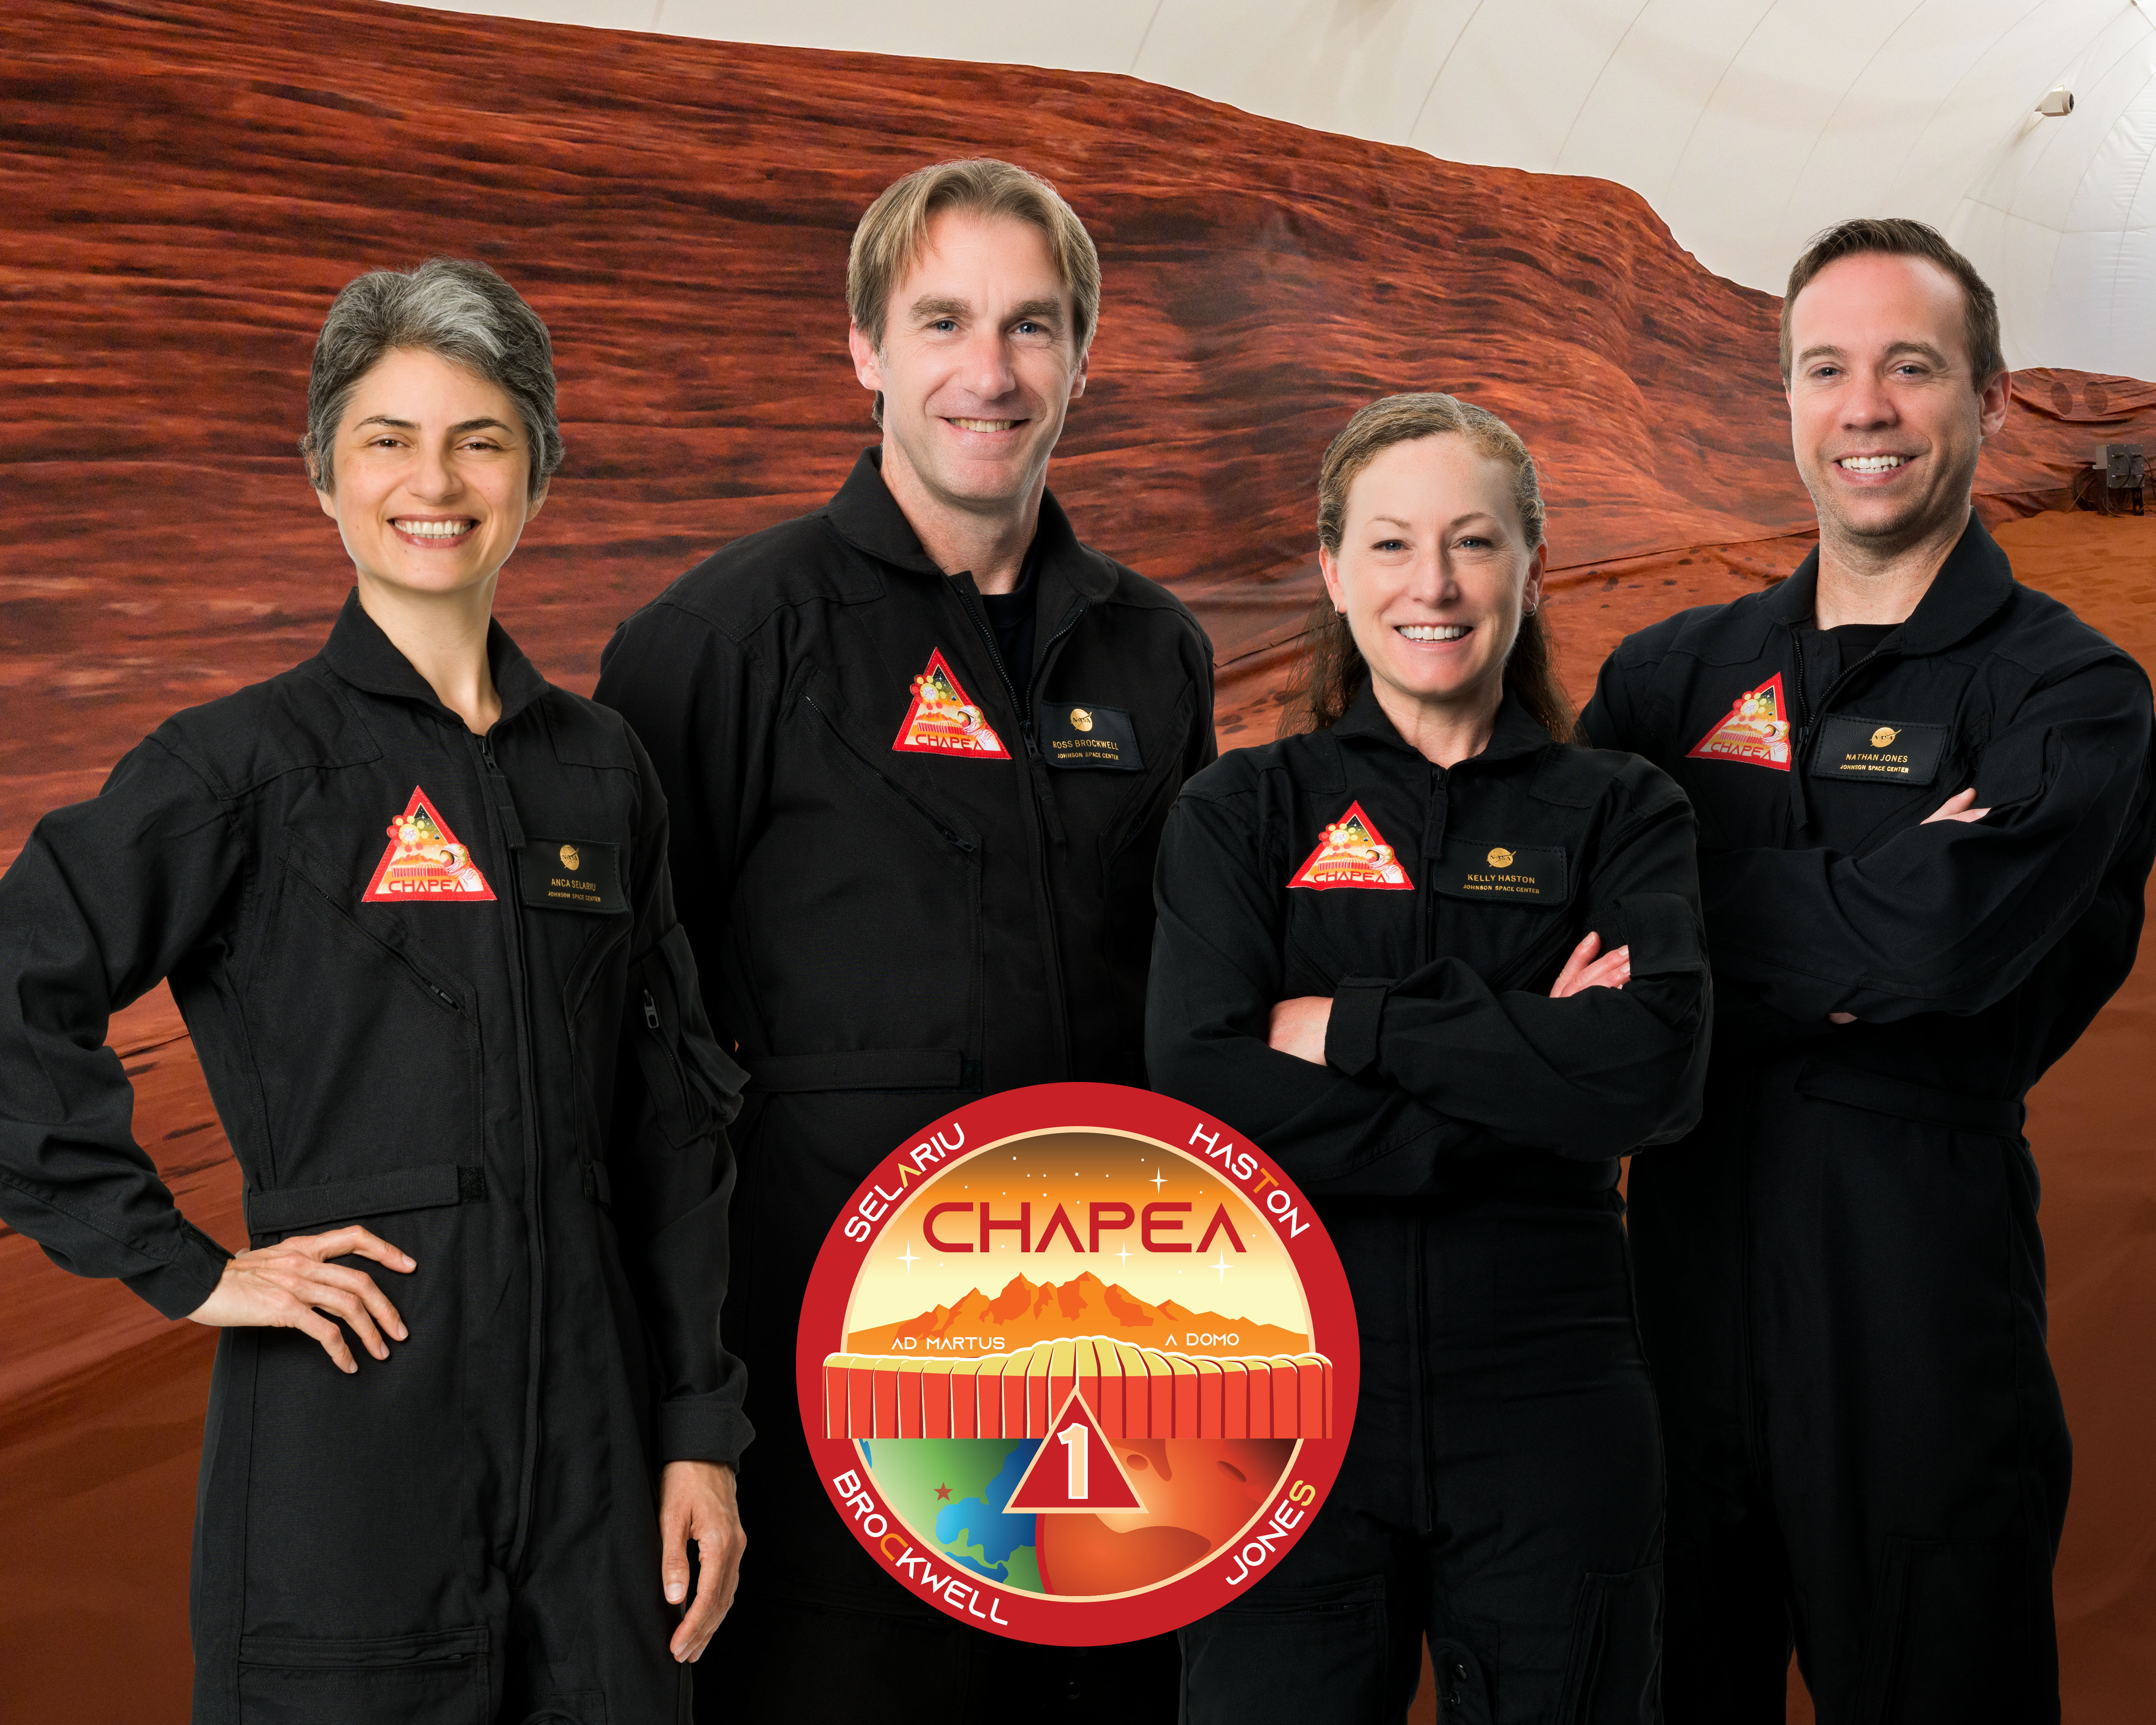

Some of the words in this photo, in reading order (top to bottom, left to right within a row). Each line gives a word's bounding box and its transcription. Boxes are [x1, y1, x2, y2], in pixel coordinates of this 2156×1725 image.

[915, 734, 985, 750] CHAPEA
[1053, 740, 1073, 749] ROSS
[1075, 739, 1119, 750] BROCKWELL
[1710, 741, 1772, 760] CHAPEA
[1880, 754, 1908, 763] JONES
[1313, 871, 1387, 884] CHAPEA
[1467, 874, 1496, 882] KELLY
[1498, 875, 1535, 884] HASTON
[388, 879, 466, 894] CHAPEA
[551, 878, 570, 888] ANCA
[571, 880, 596, 891] SELARIU
